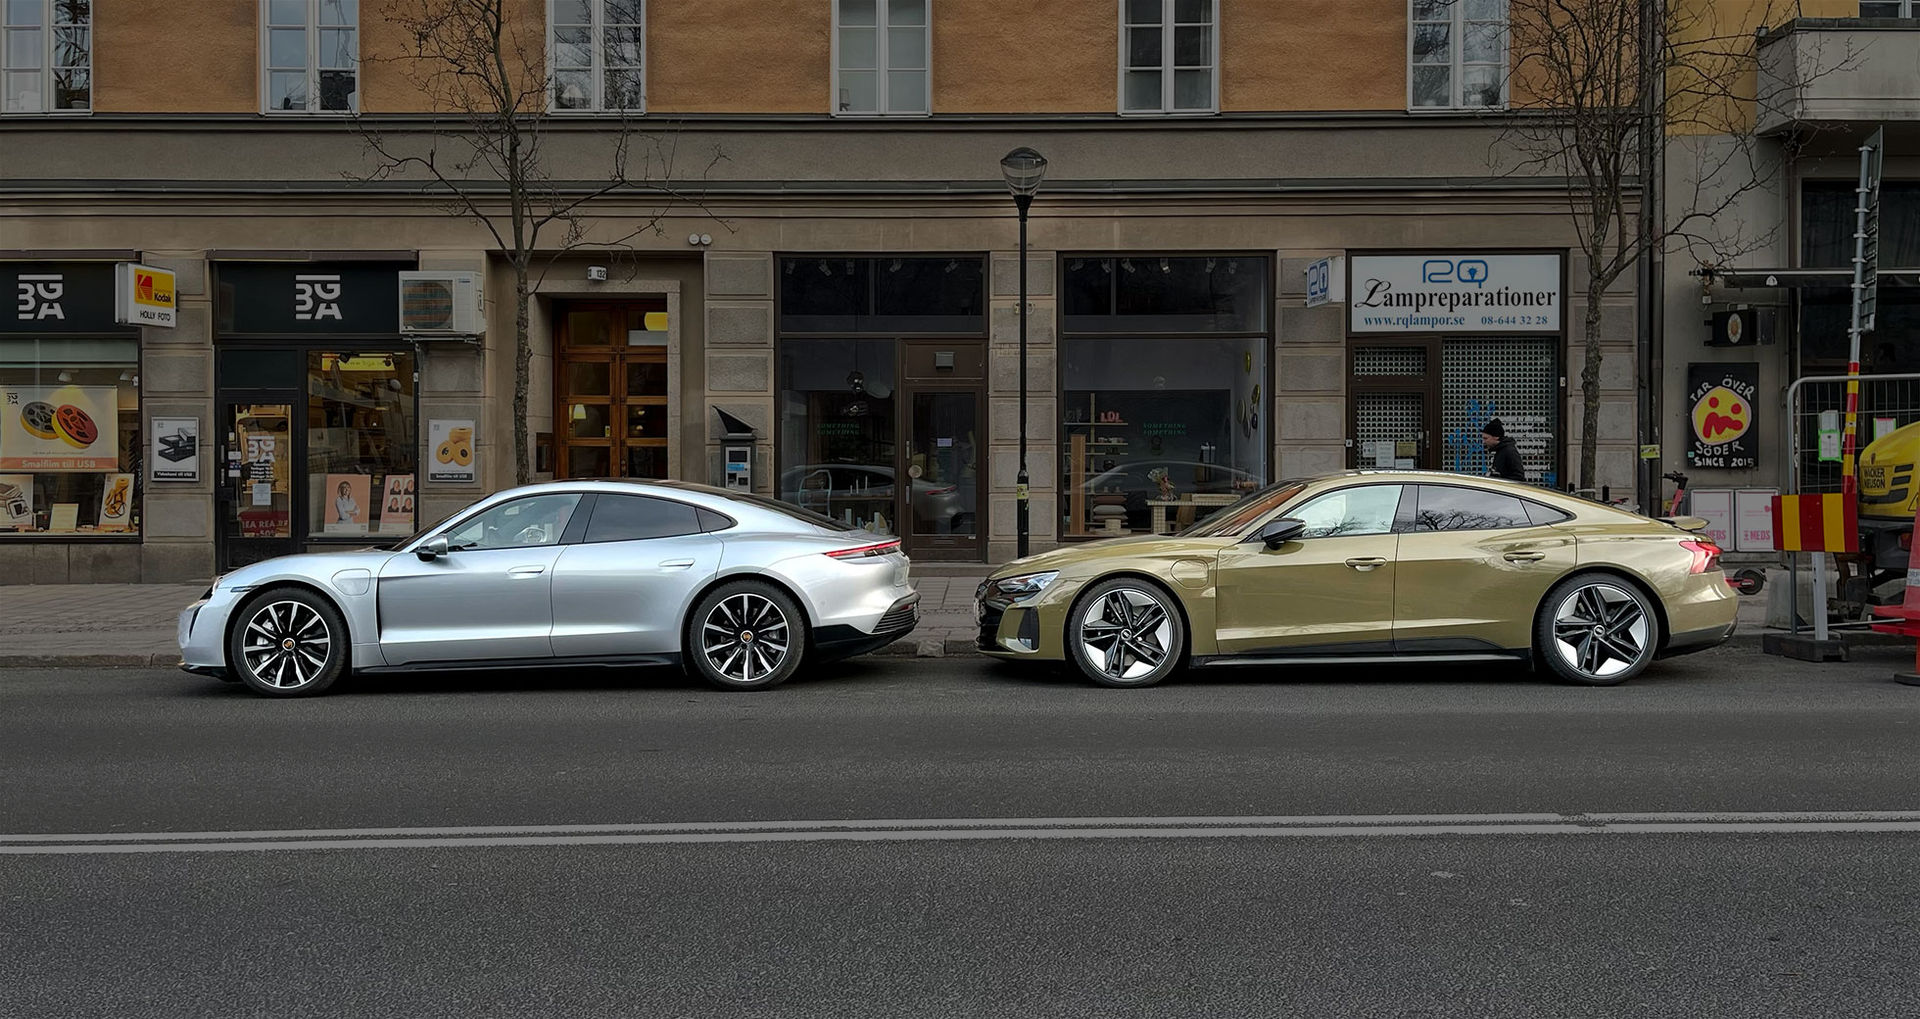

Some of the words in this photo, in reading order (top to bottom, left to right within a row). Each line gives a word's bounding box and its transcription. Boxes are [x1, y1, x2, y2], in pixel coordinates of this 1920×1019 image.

[154, 291, 171, 303] Kodak
[1354, 278, 1556, 312] Lampreparationer
[140, 310, 156, 319] HOLLY
[157, 312, 171, 322] FOTO
[1364, 313, 1465, 328] www.rqlampor.se
[1481, 315, 1516, 326] 08-644
[1519, 315, 1533, 326] 32
[1535, 315, 1548, 326] 28
[1690, 381, 1713, 402] TAR
[1722, 374, 1755, 399] ÖVER
[1695, 441, 1744, 456] SÖDER
[22, 460, 60, 468] Smalfilm
[63, 459, 76, 468] till
[77, 460, 96, 468] USB
[1694, 457, 1725, 467] SINCE
[1731, 457, 1754, 467] 2015
[258, 520, 275, 528] REA
[1750, 530, 1771, 540] MEDS
